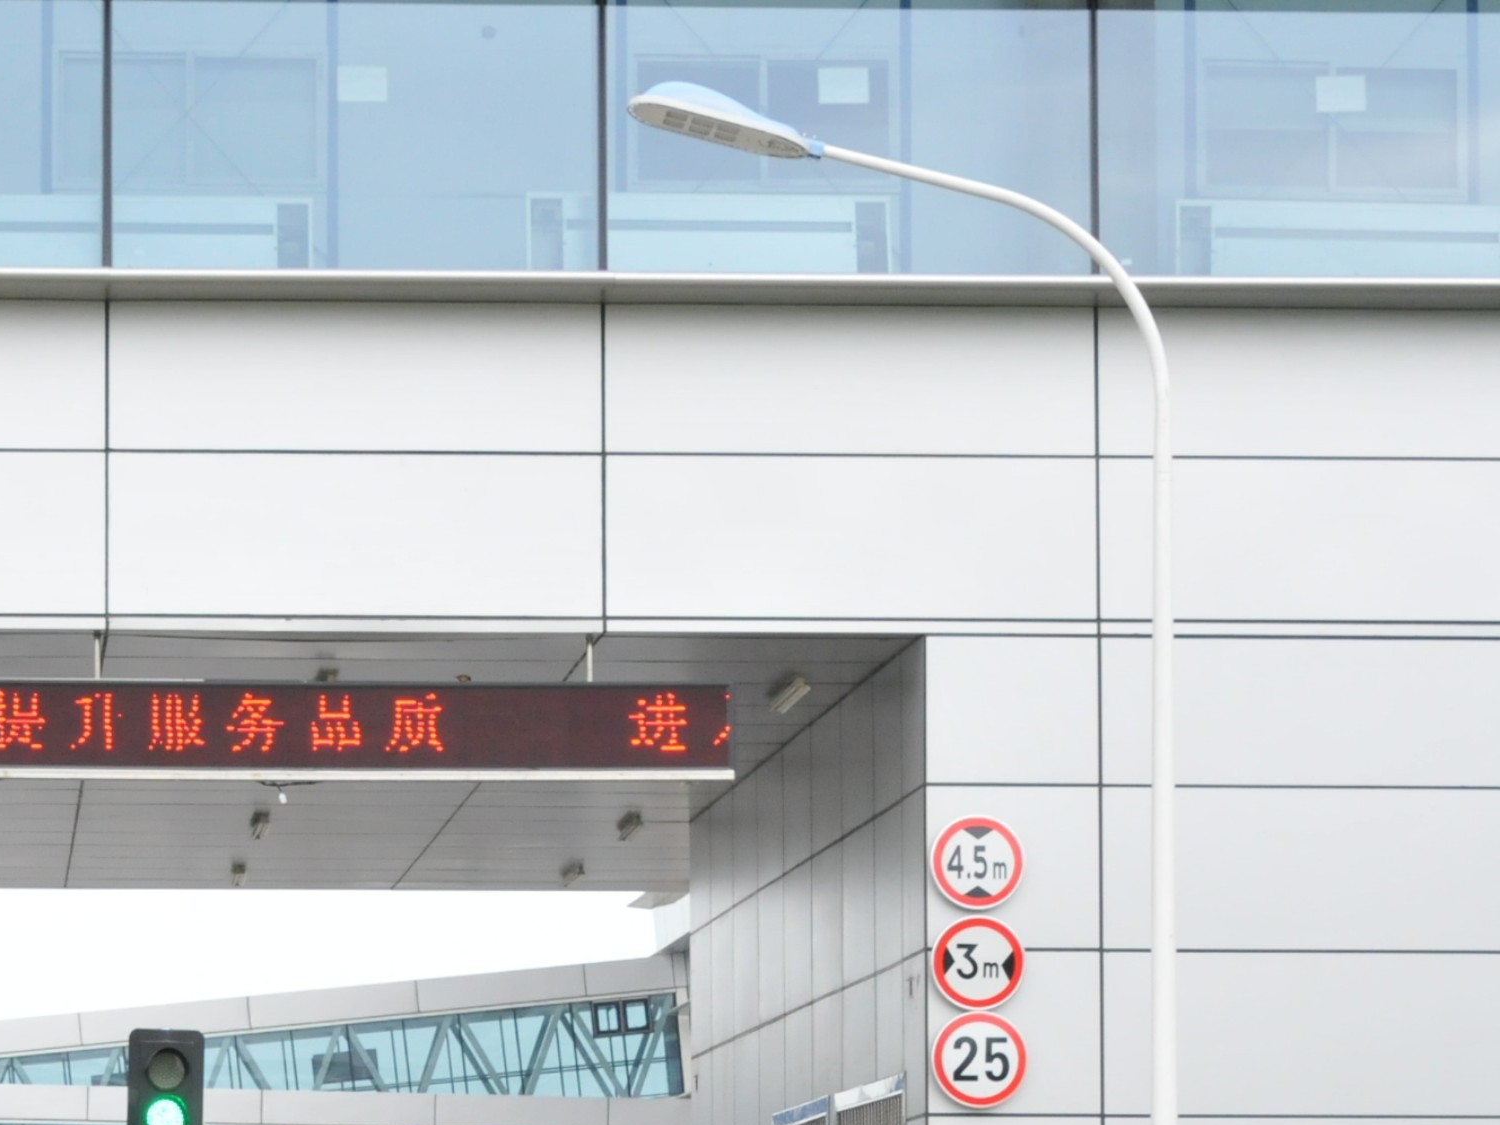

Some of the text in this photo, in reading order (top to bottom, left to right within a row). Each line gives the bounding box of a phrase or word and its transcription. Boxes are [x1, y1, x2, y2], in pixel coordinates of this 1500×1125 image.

[946, 844, 1008, 880] 4.5m
[955, 943, 1000, 980] 3m
[952, 1036, 1010, 1082] 25
